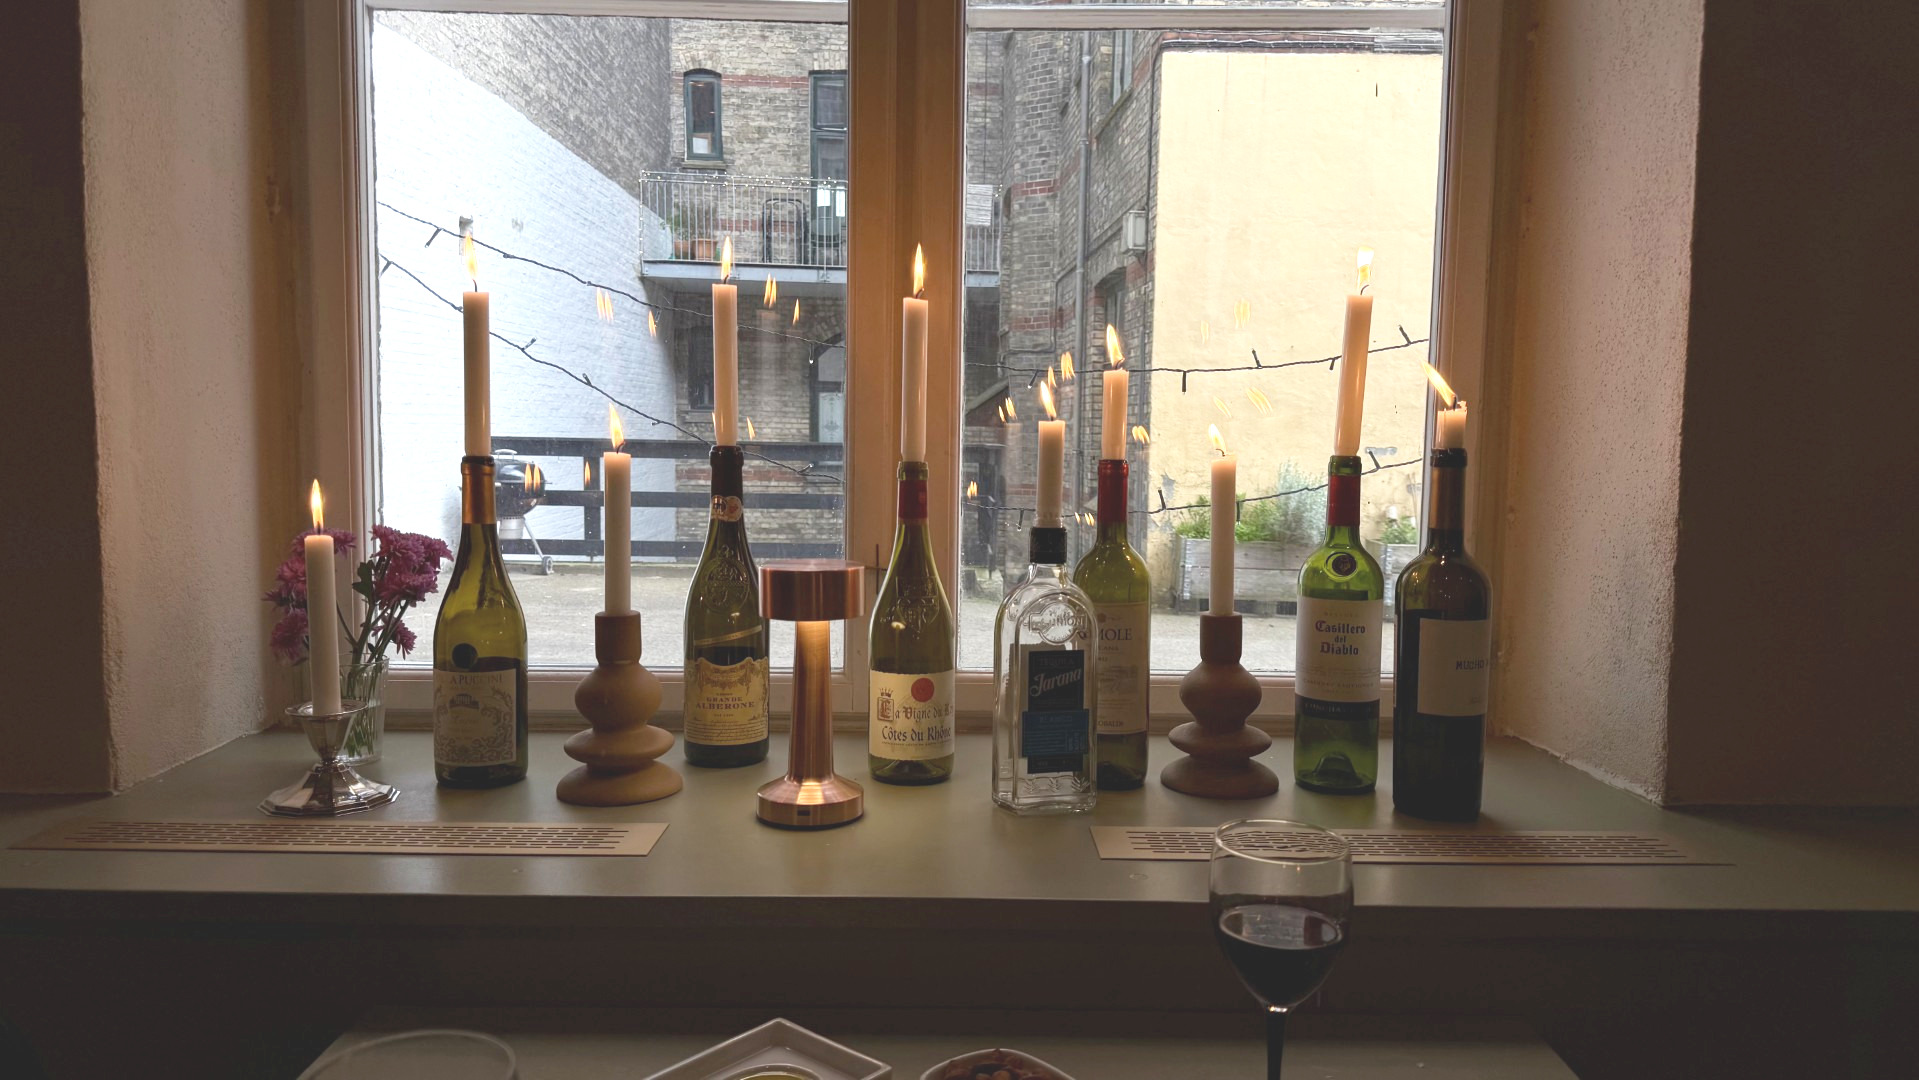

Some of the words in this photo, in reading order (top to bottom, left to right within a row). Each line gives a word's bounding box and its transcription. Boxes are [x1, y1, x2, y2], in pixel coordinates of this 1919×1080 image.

[1315, 620, 1366, 634] Casillero
[1334, 634, 1346, 643] del
[1320, 642, 1359, 655] Diablo
[1030, 668, 1083, 698] Jarana
[695, 701, 756, 711] ALBERONE
[706, 696, 743, 704] GRANDE
[902, 705, 932, 723] Vigne
[881, 725, 908, 742] Côtes
[910, 727, 924, 742] du
[927, 725, 951, 742] Rhône
